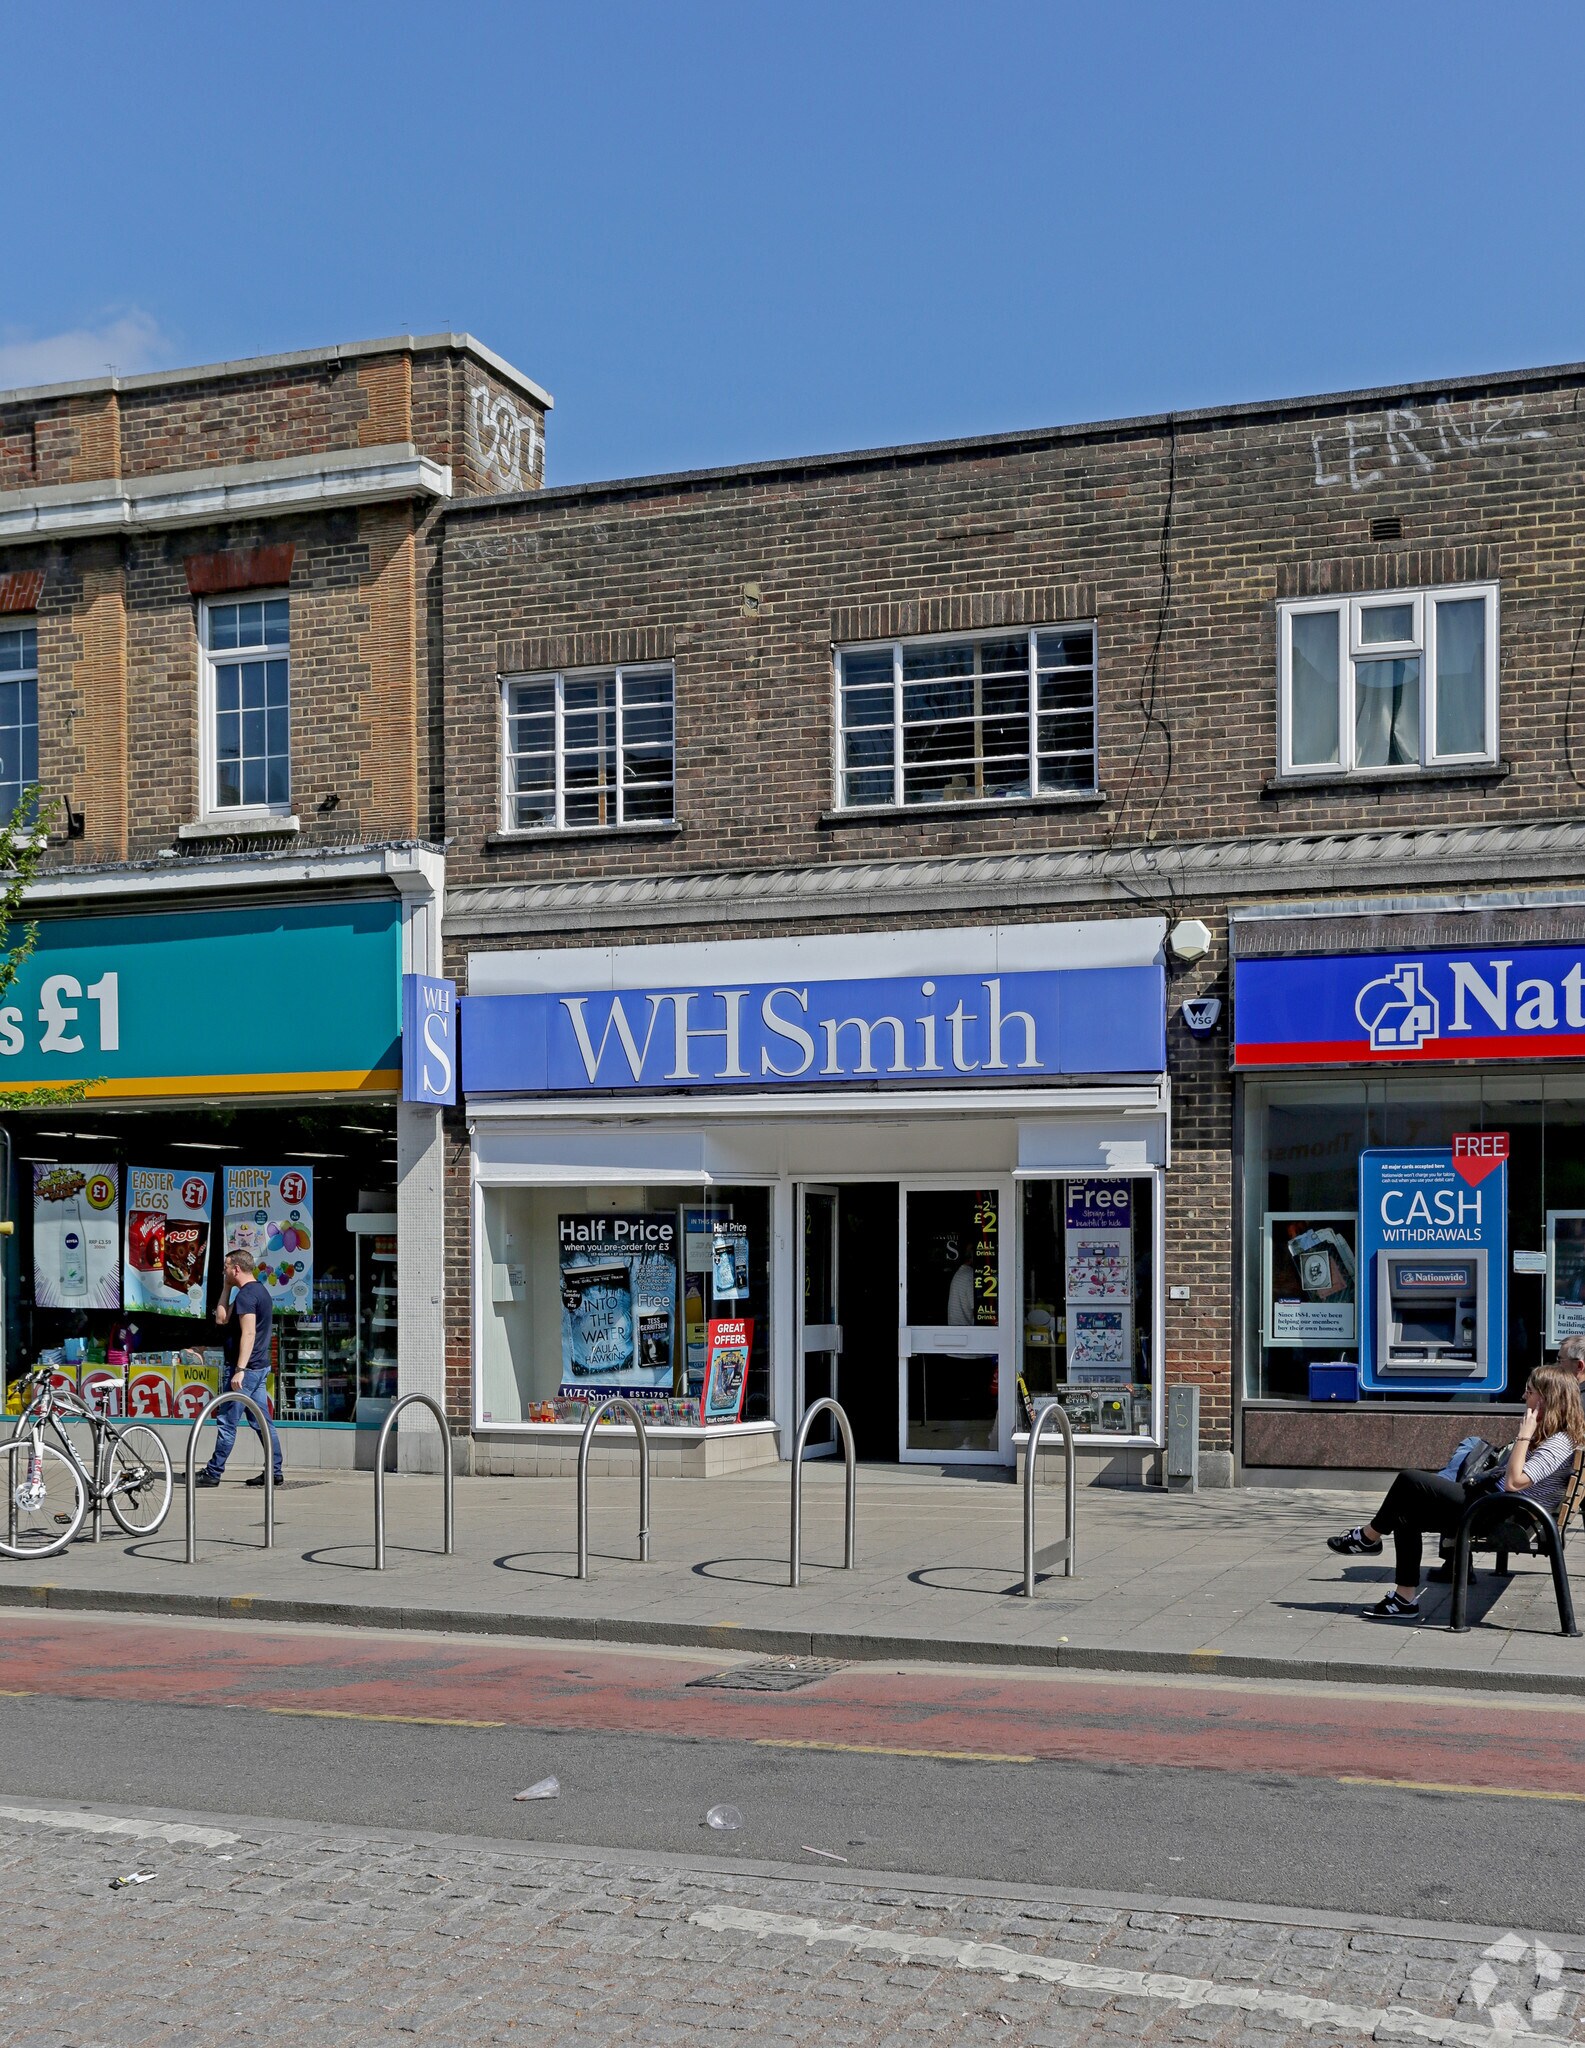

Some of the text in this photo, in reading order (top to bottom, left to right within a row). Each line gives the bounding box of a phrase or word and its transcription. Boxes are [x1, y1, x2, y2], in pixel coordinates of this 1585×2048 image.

[423, 986, 450, 1013] WH
[1448, 960, 1585, 1032] Nat
[0, 972, 119, 1055] s £1
[1191, 1017, 1211, 1025] VSG
[559, 978, 1045, 1084] WHSmith
[423, 1012, 451, 1095] S
[1455, 1136, 1504, 1157] FREE
[93, 1184, 107, 1198] £1
[132, 1171, 205, 1204] EASTER £1
[228, 1170, 303, 1199] HAPPY £1
[135, 1191, 169, 1210] EGGS
[228, 1190, 271, 1208] EASTER
[1068, 1186, 1129, 1208] Free
[983, 1201, 990, 1211] 2
[1380, 1190, 1482, 1226] CASH
[714, 1222, 747, 1232] Half Price
[974, 1212, 997, 1233] £2
[560, 1220, 674, 1241] Half Price
[1383, 1228, 1482, 1241] WITHDRAWALS
[564, 1243, 670, 1252] when you pre-order for £3
[946, 1240, 959, 1260] S
[976, 1241, 995, 1249] ALL
[983, 1265, 991, 1276] 2
[1415, 1273, 1464, 1282] Nationwide
[974, 1276, 998, 1297] £2
[584, 1297, 618, 1312] INTO
[638, 1293, 670, 1307] Free
[977, 1305, 996, 1314] ALL
[590, 1312, 614, 1327] THE
[640, 1322, 668, 1331] GERRITSEN
[647, 1317, 660, 1325] TESS
[582, 1327, 626, 1344] WATER
[717, 1323, 745, 1333] GREAT
[714, 1334, 746, 1344] OFFERS
[592, 1344, 619, 1354] PAULA
[585, 1351, 626, 1364] HAWKINS
[184, 1368, 210, 1381] WOW!
[131, 1380, 168, 1418] £1
[562, 1388, 623, 1402] WHSmith
[1175, 1404, 1189, 1428] 5
